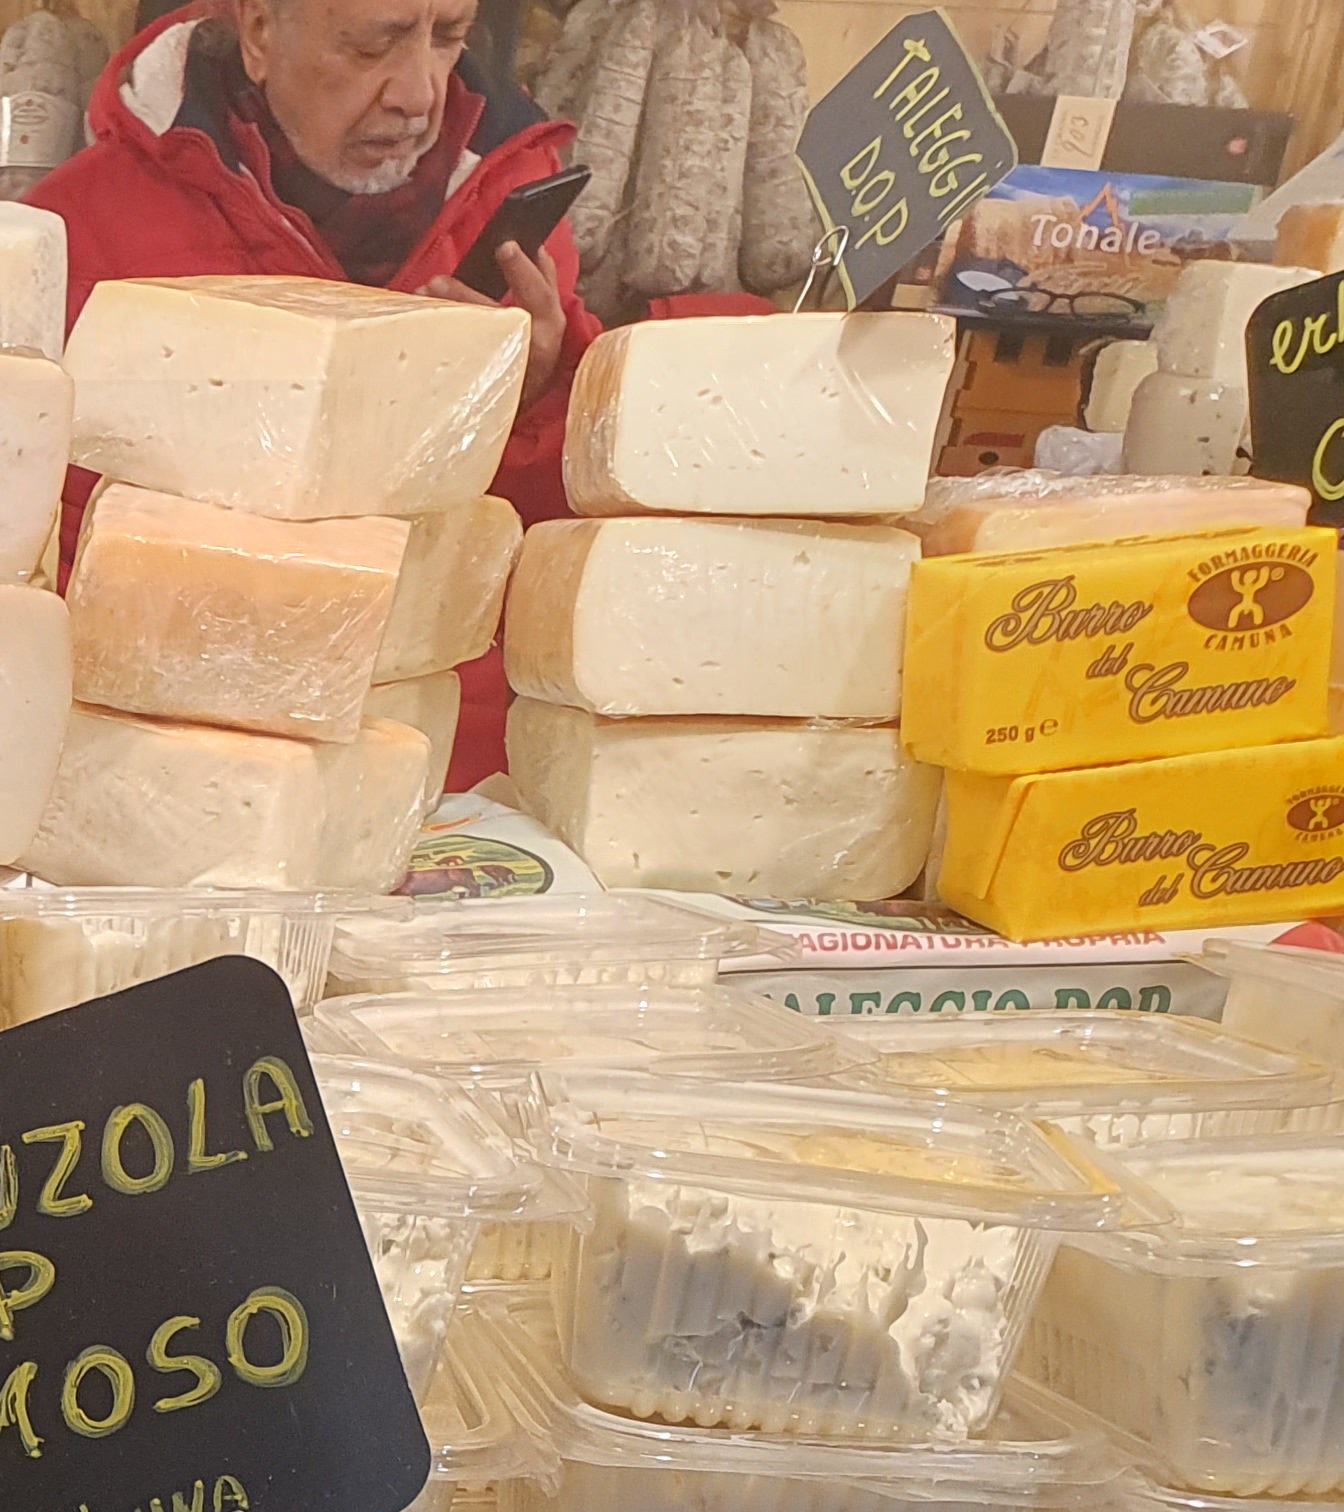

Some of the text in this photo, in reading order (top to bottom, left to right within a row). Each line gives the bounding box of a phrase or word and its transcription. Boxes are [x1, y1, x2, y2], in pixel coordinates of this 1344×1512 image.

[1030, 213, 1162, 256] Tonale
[1187, 543, 1319, 583] FORMAGGERIA
[985, 575, 1154, 652] Burro
[1204, 623, 1292, 651] CAMUNA
[1086, 642, 1135, 680] del
[1124, 661, 1297, 725] Camuno
[985, 726, 1019, 745] 250
[1058, 808, 1203, 872] Burro
[1138, 872, 1185, 908] del
[1187, 842, 1344, 900] Camuno
